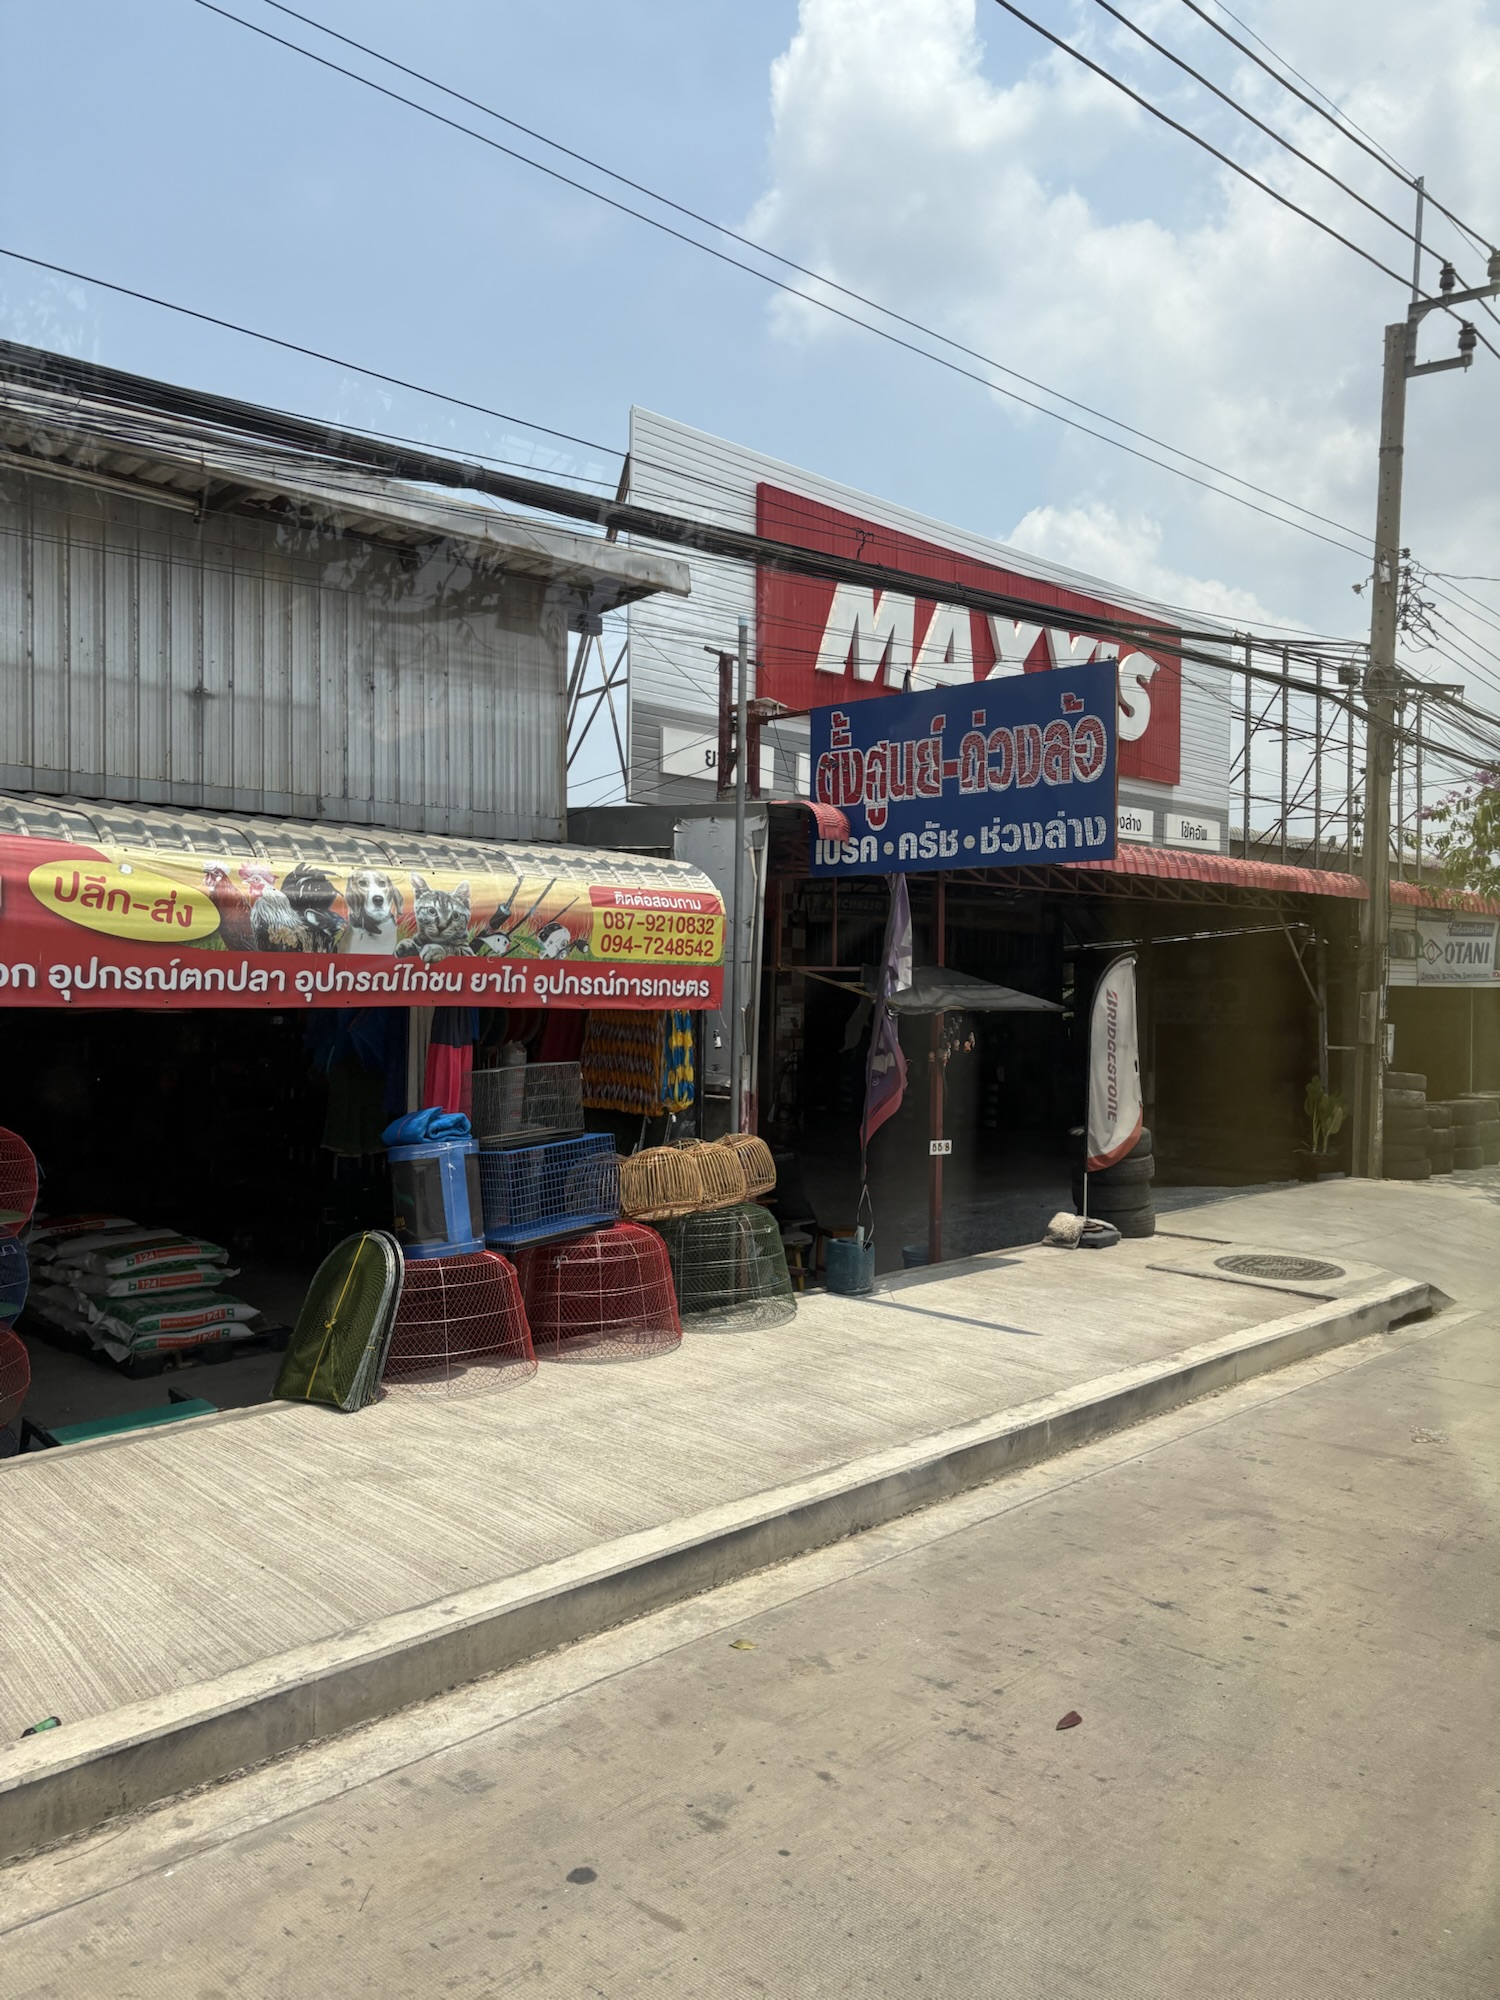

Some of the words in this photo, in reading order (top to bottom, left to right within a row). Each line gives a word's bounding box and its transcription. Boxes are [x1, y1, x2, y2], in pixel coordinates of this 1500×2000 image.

[815, 582, 1161, 741] MAXS
[980, 811, 1107, 855] ช่วงล่าง
[54, 869, 193, 928] ปลีก-ส่ง
[614, 890, 702, 911] ติดต่อสอบถาม
[603, 911, 715, 935] 087-9210832
[600, 934, 714, 957] 094-7248542
[1444, 942, 1490, 964] OTANI
[48, 956, 286, 1001] อุปกรณ์ตกปลา
[295, 963, 463, 1002] อุปกรณ์ไก่ชน
[470, 965, 528, 993] ยาไก่
[533, 968, 710, 1004] อุปกรณ์การเกษตร
[1105, 988, 1119, 1123] BRIDGESTONE
[138, 1252, 155, 1262] 124
[141, 1279, 157, 1289] 124
